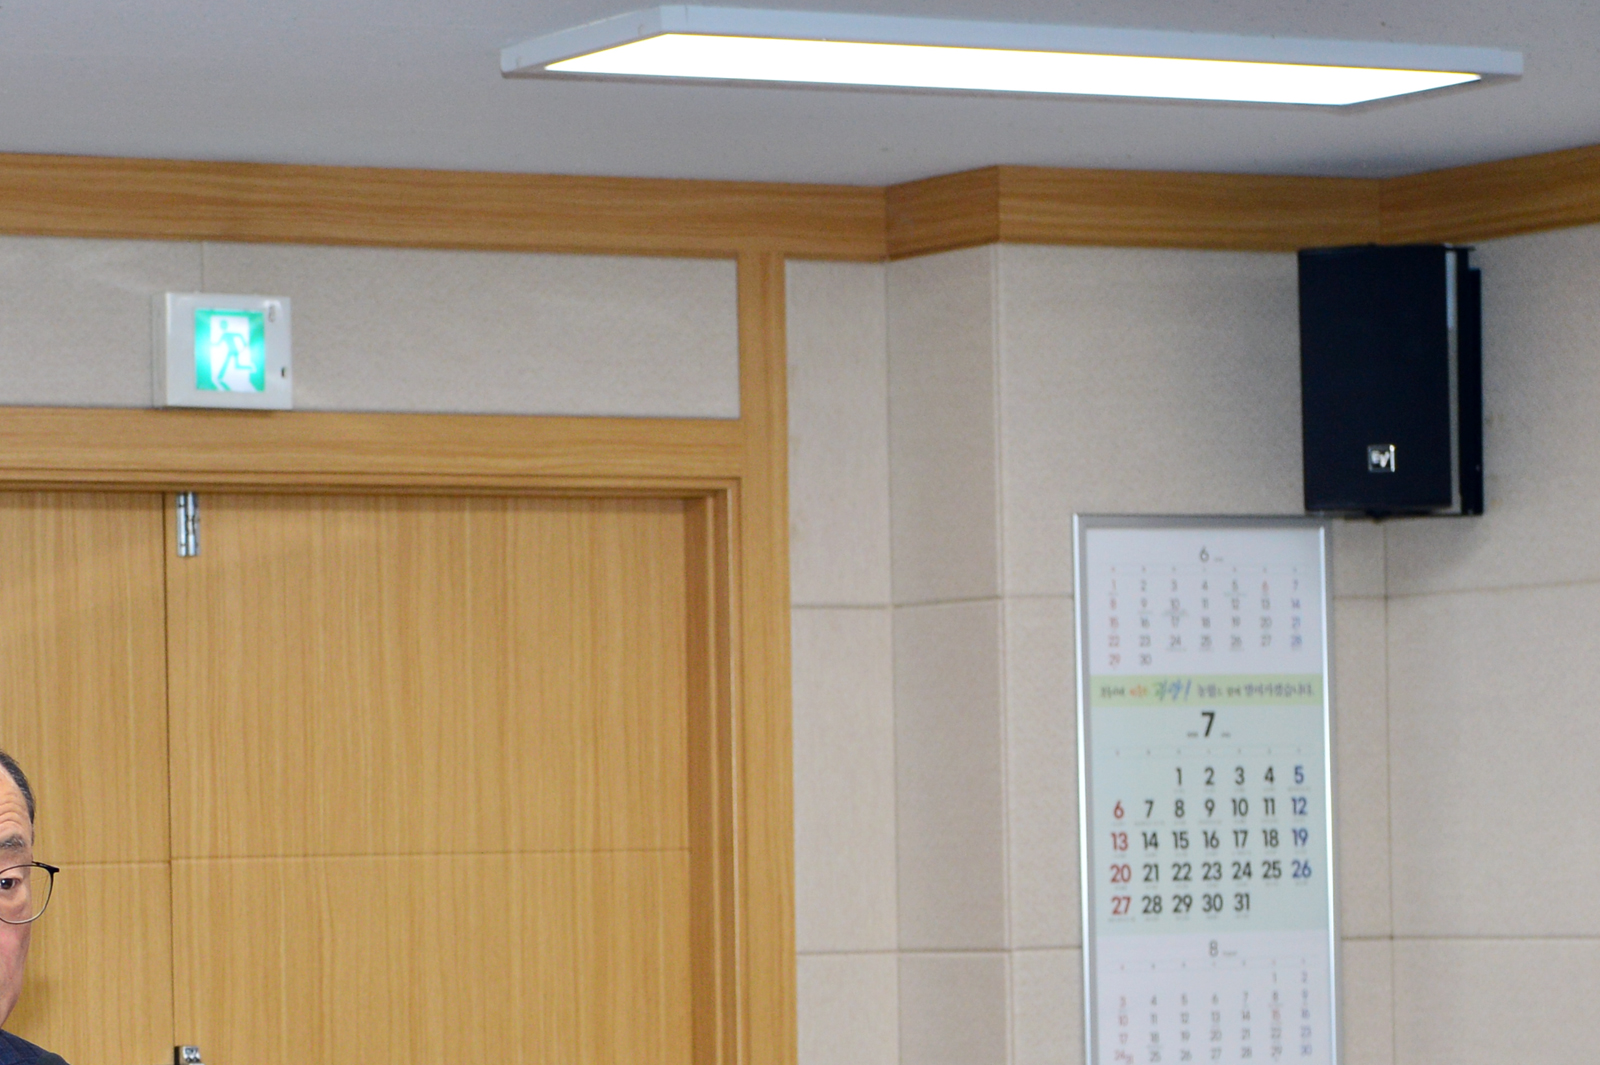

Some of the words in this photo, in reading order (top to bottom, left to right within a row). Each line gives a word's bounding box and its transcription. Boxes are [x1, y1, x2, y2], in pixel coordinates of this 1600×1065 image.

[1199, 546, 1209, 562] 6
[1201, 711, 1215, 737] 7
[1176, 767, 1182, 785] 1
[1205, 767, 1214, 786] 2
[1235, 766, 1245, 786] 3
[1265, 767, 1274, 783] 4
[1294, 765, 1304, 784] 5
[1114, 801, 1124, 819] 6
[1145, 799, 1154, 818] 7
[1175, 799, 1185, 818] 8
[1205, 799, 1215, 817] 9
[1231, 798, 1249, 817] 10
[1263, 798, 1275, 815] 11
[1291, 797, 1307, 815] 12
[1111, 832, 1128, 851] 13
[1142, 832, 1159, 849] 14
[1172, 831, 1189, 850] 15
[1203, 831, 1220, 849] 16
[1233, 829, 1248, 847] 17
[1262, 829, 1279, 848] 18
[1292, 828, 1308, 846] 19
[1110, 864, 1131, 883] 20
[1143, 863, 1159, 882] 21
[1172, 863, 1192, 881] 22
[1202, 862, 1222, 881] 23
[1232, 861, 1252, 880] 24
[1262, 861, 1282, 879] 25
[1292, 860, 1312, 878] 26
[1112, 896, 1131, 915] 27
[1142, 895, 1163, 914] 28
[1173, 895, 1193, 913] 29
[1203, 893, 1223, 913] 30
[1234, 893, 1250, 912] 31
[1209, 940, 1218, 957] 8
